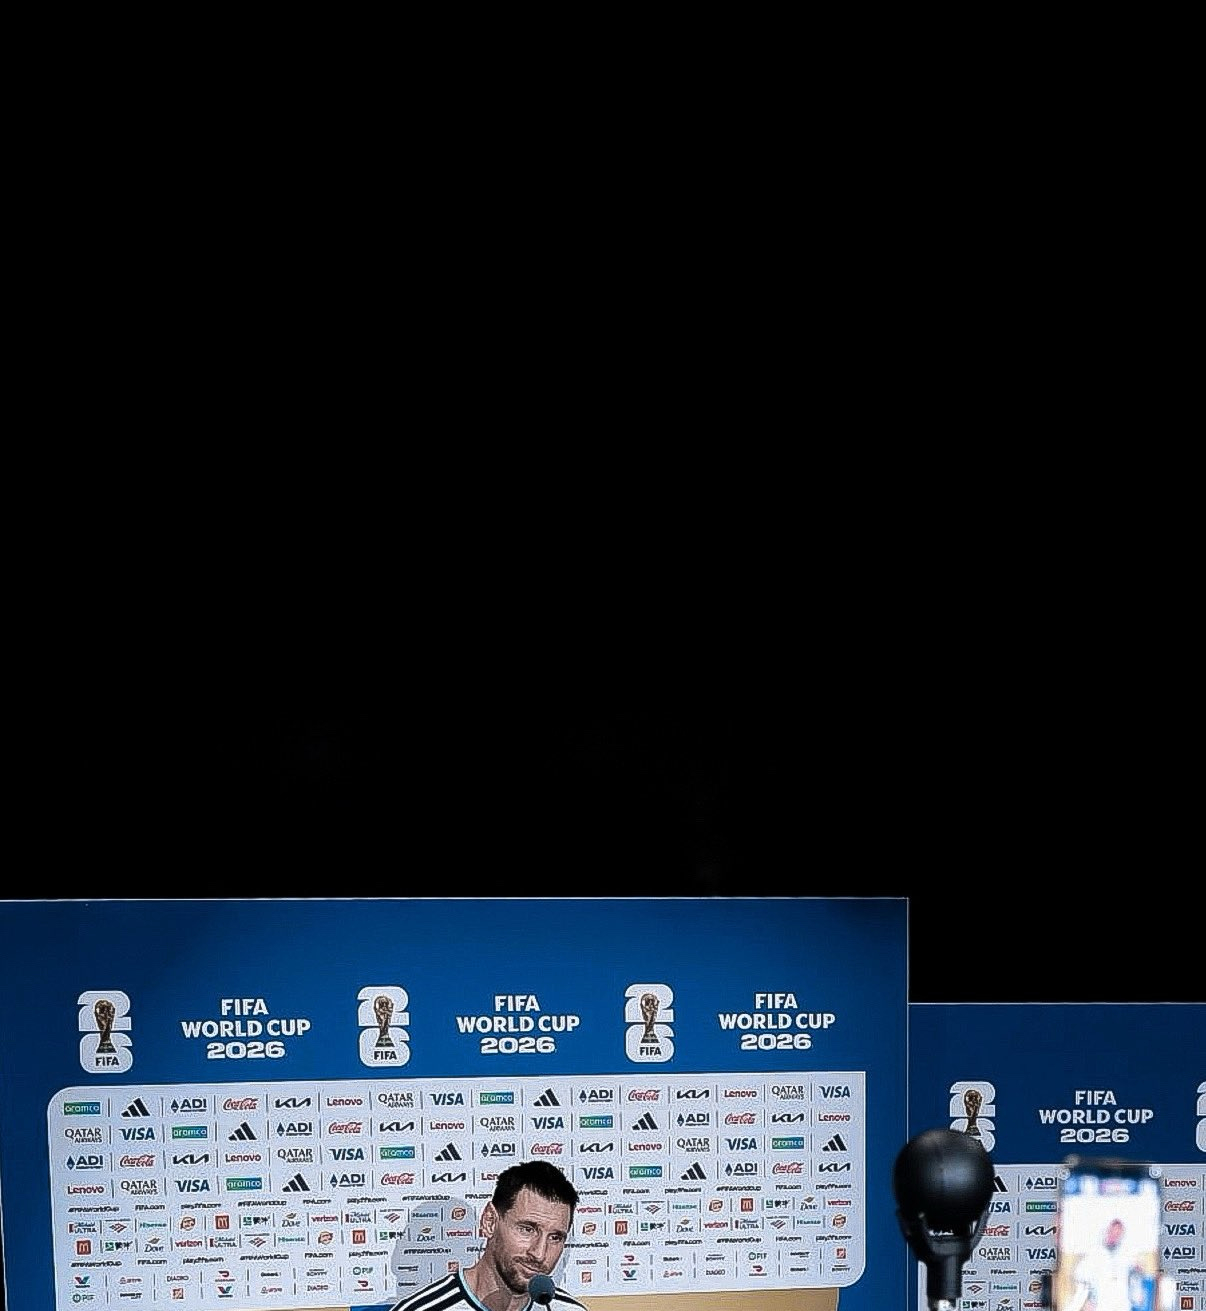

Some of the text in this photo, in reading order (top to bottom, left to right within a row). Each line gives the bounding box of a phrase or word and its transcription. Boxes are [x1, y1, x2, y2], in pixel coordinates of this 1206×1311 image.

[221, 998, 269, 1016] FIFA
[494, 995, 541, 1012] FIFA
[755, 993, 798, 1010] FIFA
[456, 1015, 581, 1033] WORLD CUP
[718, 1013, 836, 1030] WORLD CUP
[181, 1019, 312, 1038] WORLD CUP
[480, 1036, 556, 1054] 2026
[740, 1033, 812, 1050] 2026
[206, 1041, 286, 1060] 2026
[373, 1050, 398, 1061] FIFA
[639, 1046, 662, 1056] FIFA
[95, 1057, 120, 1068] FIFA
[588, 1089, 613, 1099] ADI
[724, 1090, 757, 1098] Lenovo
[772, 1085, 804, 1095] QATAR
[818, 1086, 850, 1098] VISA
[180, 1098, 207, 1109] ADI
[327, 1097, 363, 1106] Lenovo
[378, 1093, 413, 1103] QATAR
[430, 1093, 464, 1106] VISA
[1075, 1090, 1117, 1106] FIFA
[480, 1116, 515, 1127] QATAR
[685, 1113, 709, 1122] ADI
[818, 1113, 850, 1122] Lenovo
[1039, 1109, 1154, 1125] WORLD CUP
[286, 1122, 312, 1133] ADI
[430, 1121, 465, 1130] Lenovo
[531, 1117, 564, 1129] VISA
[64, 1128, 102, 1139] QATAR
[119, 1127, 155, 1141] VISA
[1060, 1128, 1130, 1143] 2026
[628, 1142, 662, 1151] Lenovo
[677, 1137, 710, 1147] QATAR
[725, 1137, 757, 1150] VISA
[278, 1148, 313, 1159] QATAR
[329, 1148, 364, 1160] VISA
[490, 1143, 515, 1154] ADI
[76, 1155, 103, 1166] ADI
[225, 1153, 261, 1162] Lenovo
[580, 1167, 614, 1179] VISA
[734, 1163, 758, 1173] ADI
[339, 1173, 365, 1184] ADI
[481, 1172, 499, 1181] Len
[1034, 1177, 1057, 1186] ADI
[121, 1180, 157, 1190] QATAR
[175, 1179, 210, 1192] VISA
[1164, 1178, 1197, 1187] Lenovo
[68, 1185, 104, 1194] Lenovo
[990, 1201, 1011, 1212] ISA
[1164, 1224, 1196, 1236] VISA
[979, 1248, 1010, 1257] QATAR
[1026, 1248, 1056, 1260] VISA
[1171, 1247, 1196, 1257] ADI
